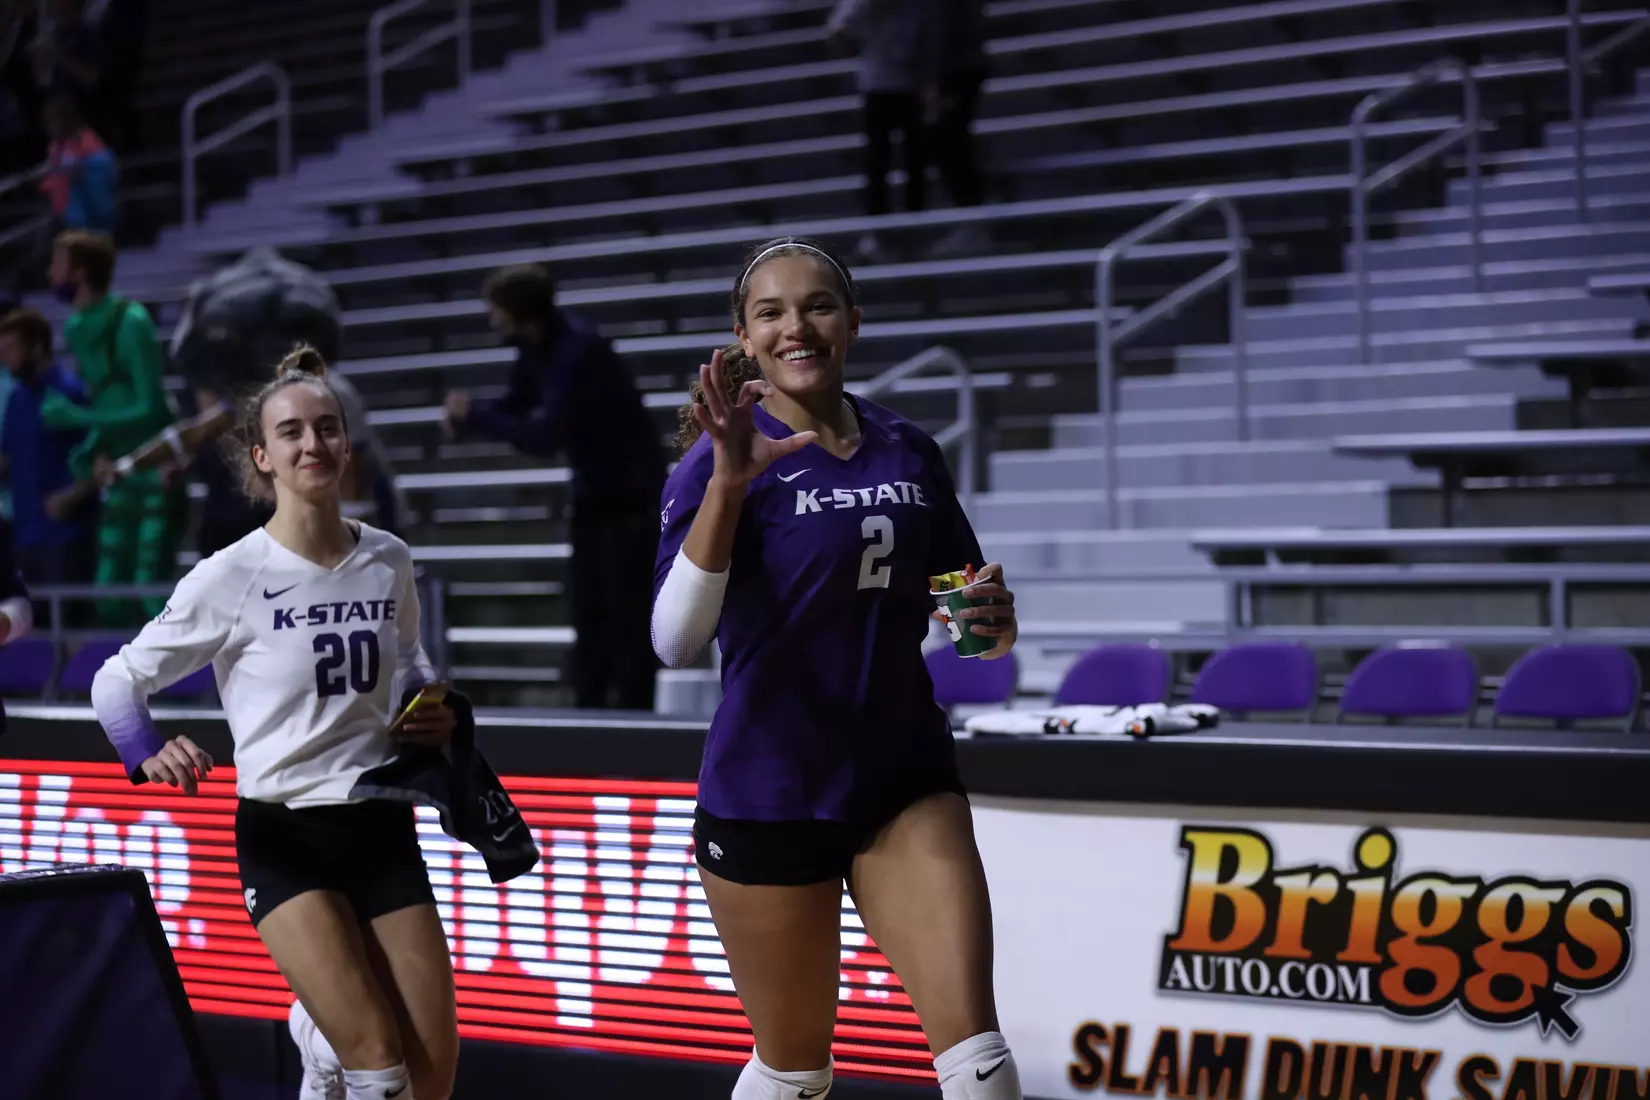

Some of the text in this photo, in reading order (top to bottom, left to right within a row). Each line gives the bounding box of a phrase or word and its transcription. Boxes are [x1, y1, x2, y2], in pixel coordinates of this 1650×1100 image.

[795, 481, 928, 515] K-STATE
[856, 514, 895, 591] 2
[273, 600, 397, 630] K-STATE
[312, 629, 380, 698] 20
[1168, 827, 1630, 1018] Briggs
[1165, 953, 1372, 1003] AUTO.COM
[1068, 1020, 1251, 1099] SLAM
[1262, 1037, 1443, 1100] DUNK
